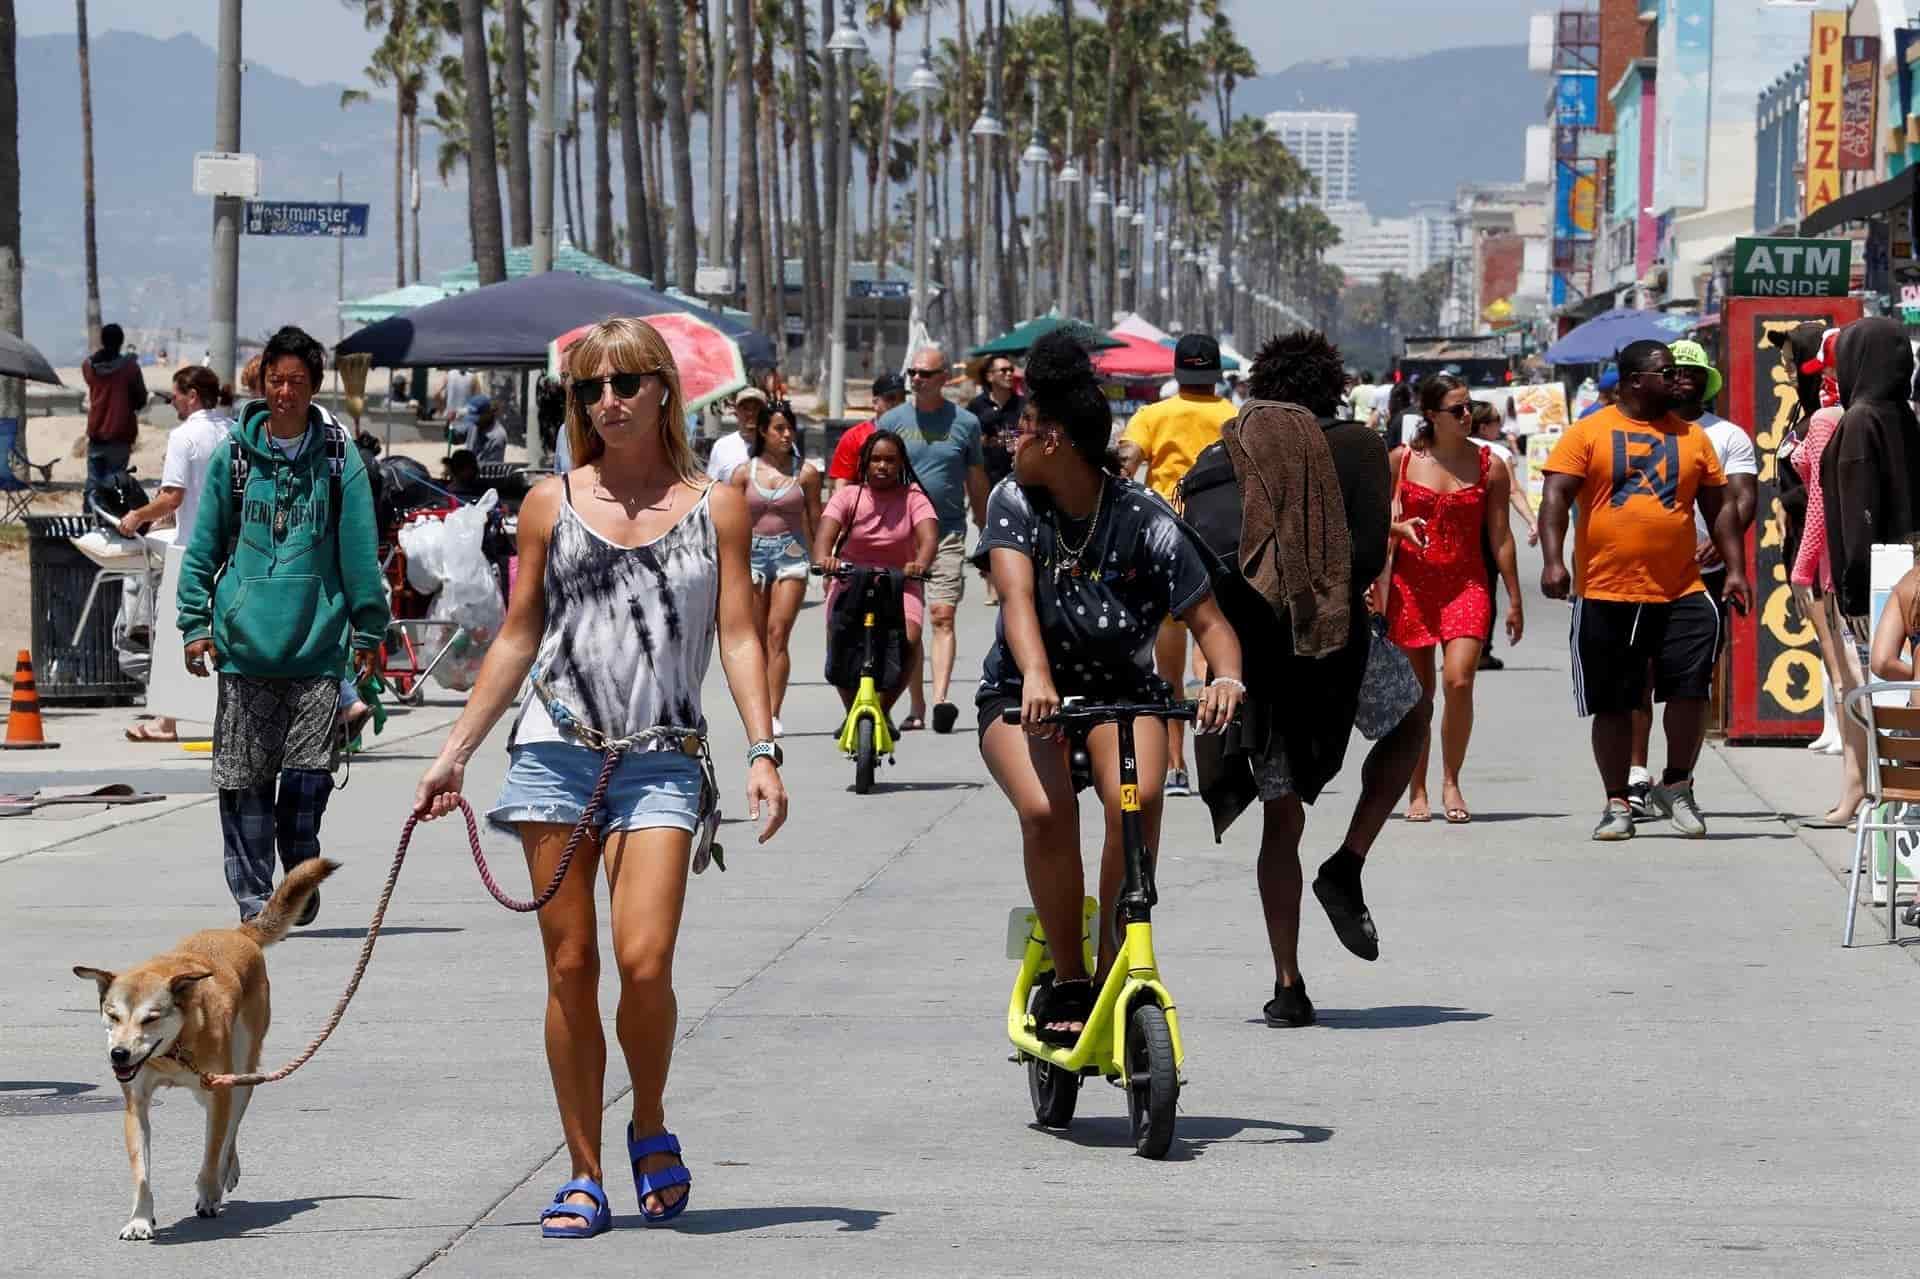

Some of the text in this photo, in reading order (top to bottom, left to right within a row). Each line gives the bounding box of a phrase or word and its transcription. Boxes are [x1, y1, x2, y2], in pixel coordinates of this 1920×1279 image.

[1813, 26, 1839, 206] PIZZA
[251, 203, 350, 223] Westminster
[1744, 246, 1840, 275] ATM
[1752, 280, 1830, 296] INSIDE
